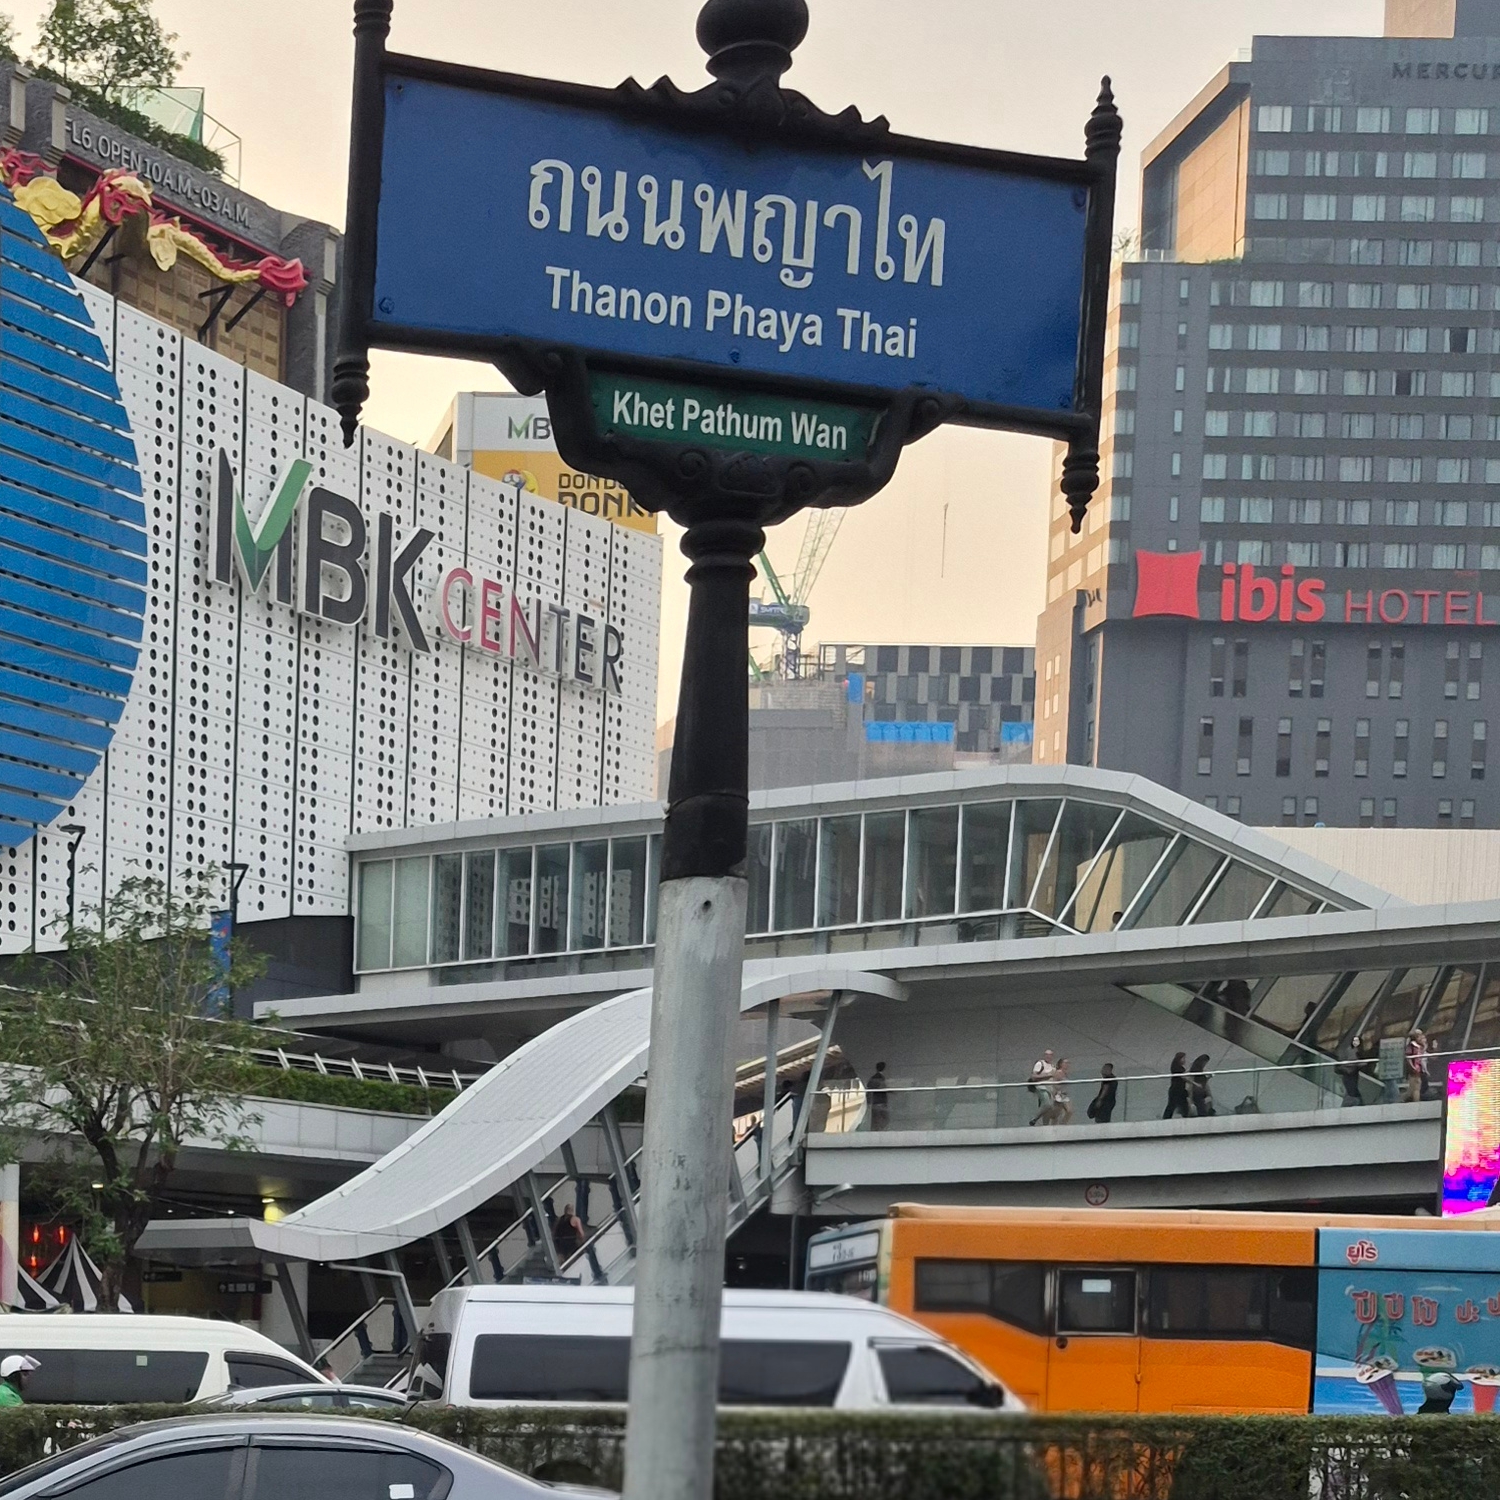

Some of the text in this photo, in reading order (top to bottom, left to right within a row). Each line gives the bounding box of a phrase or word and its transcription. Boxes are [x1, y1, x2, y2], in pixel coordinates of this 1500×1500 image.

[527, 159, 947, 290] ถนนพญาไท
[545, 265, 917, 360] Thanon Phaya Thai
[612, 390, 847, 450] Khet Pathum Wan
[206, 446, 437, 656] MBK
[1220, 562, 1498, 625] ibis HOTEL
[440, 565, 623, 697] CENTER
